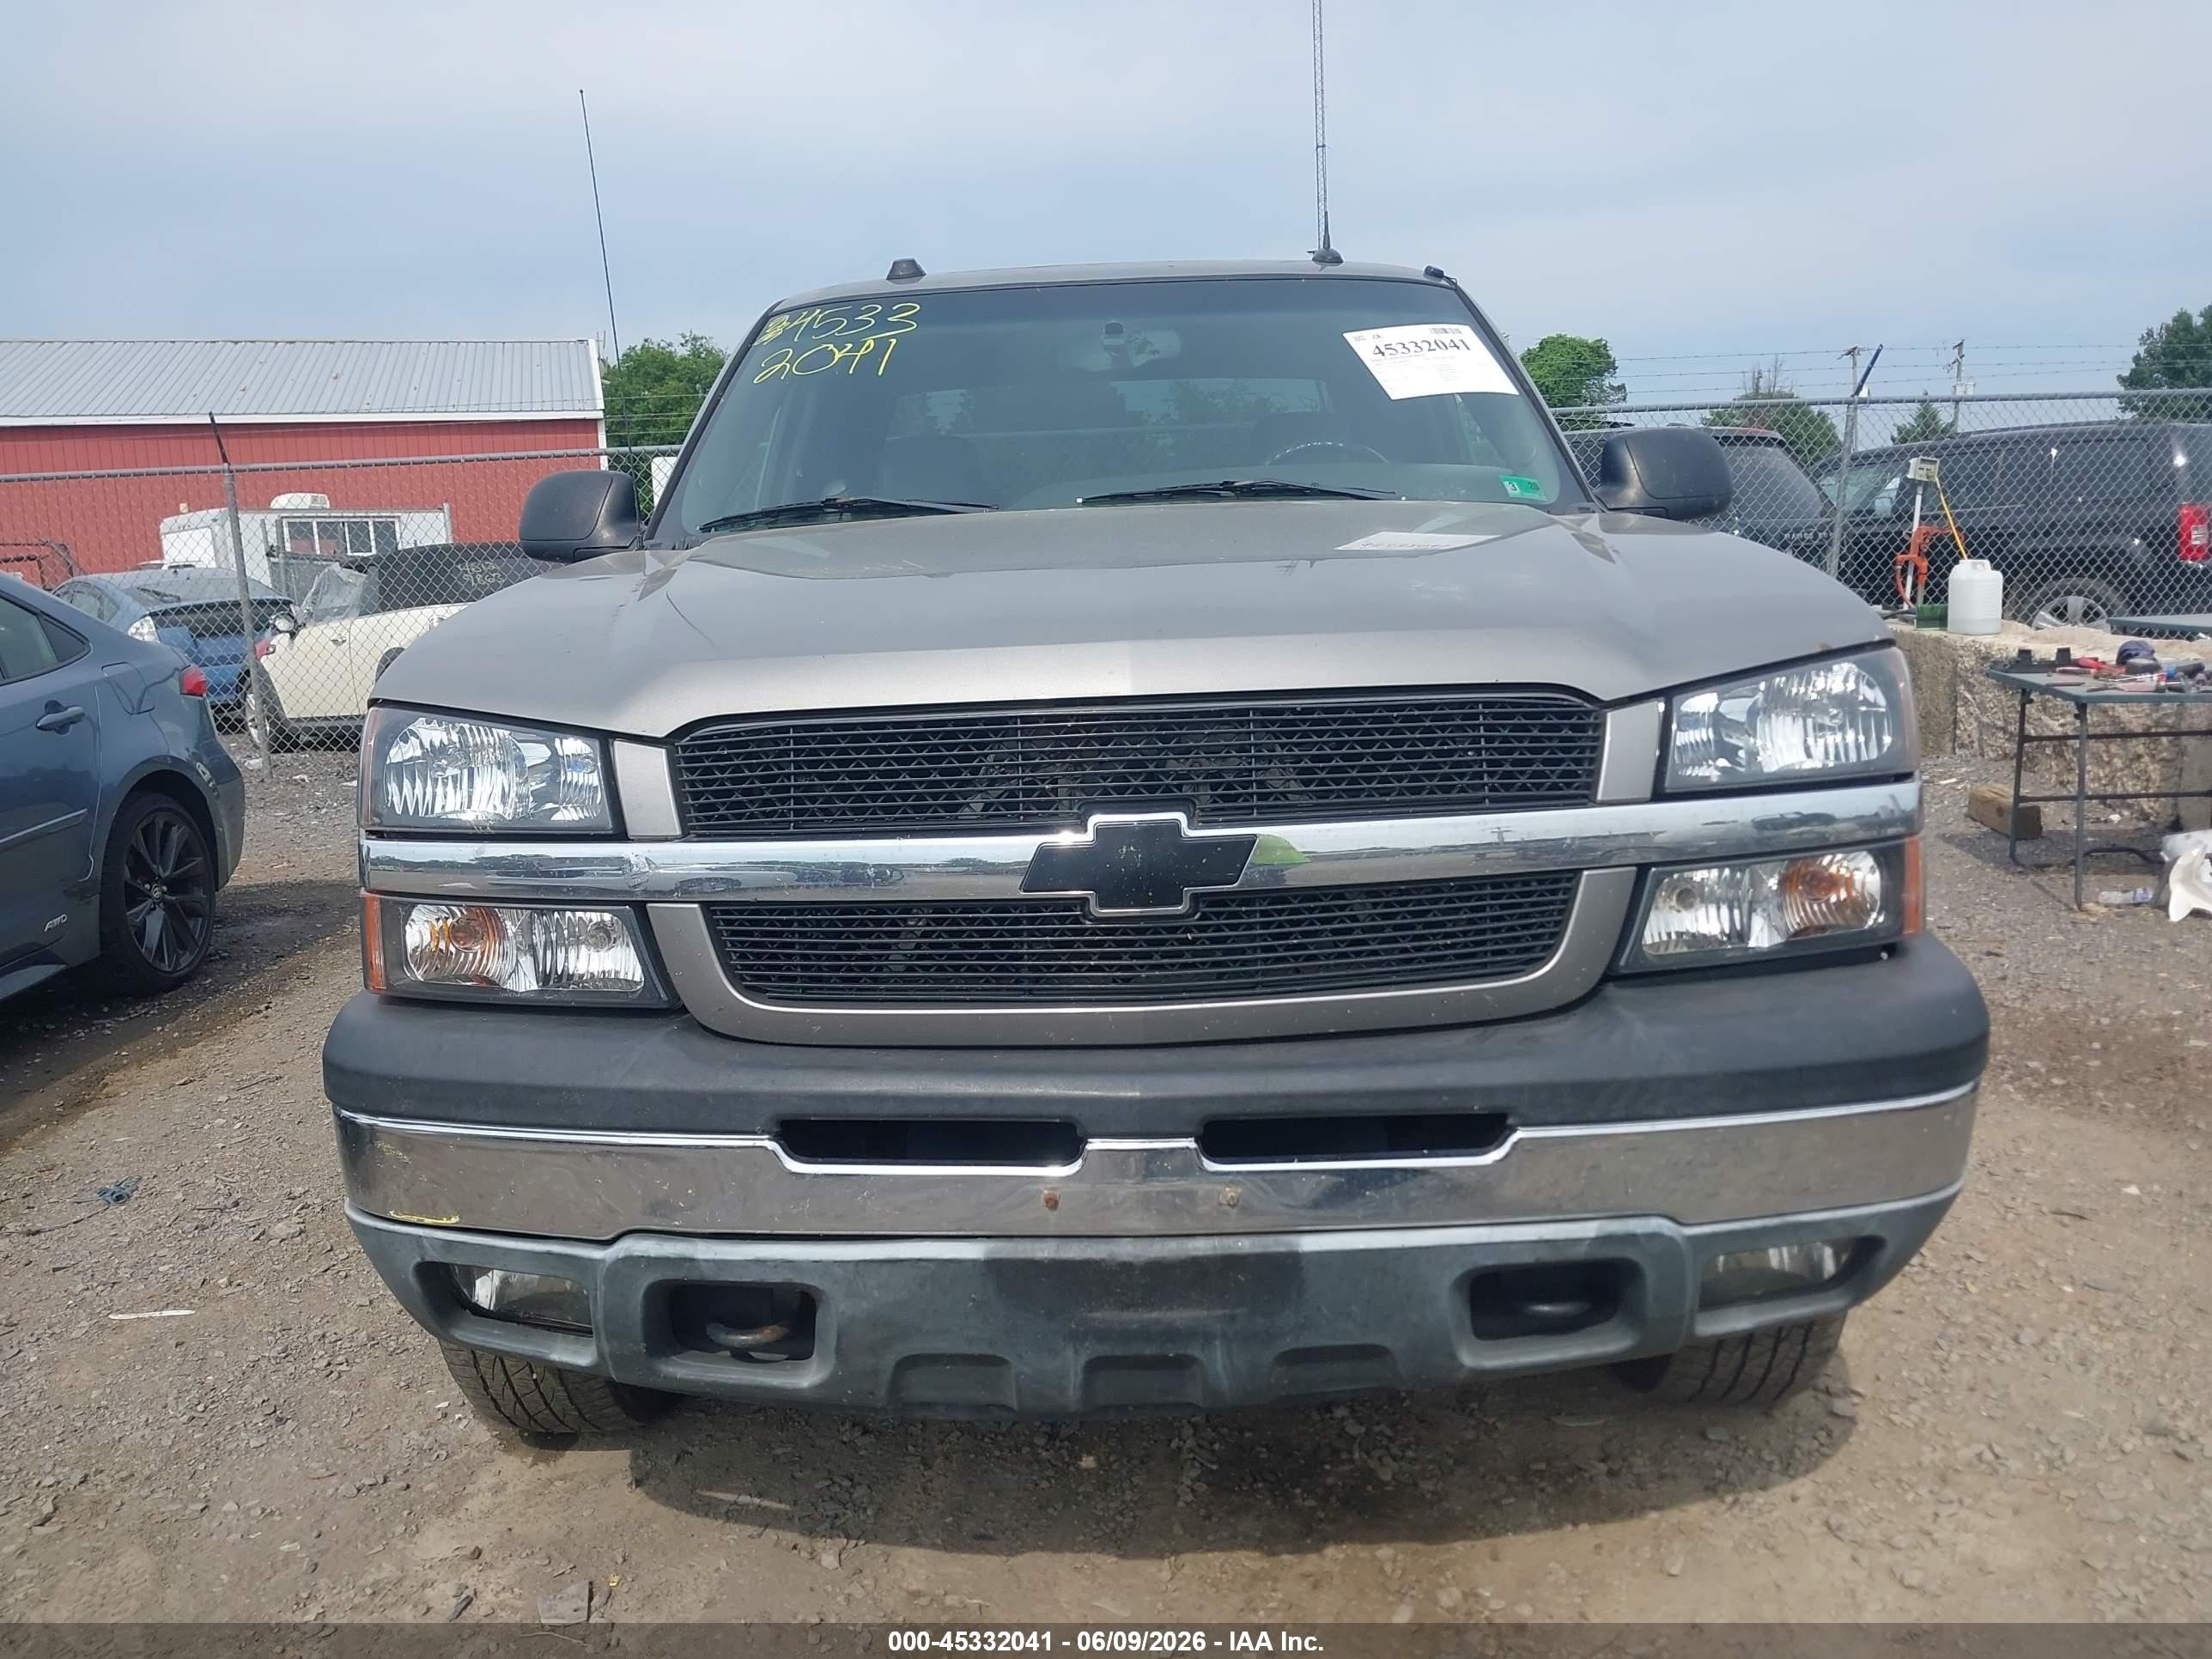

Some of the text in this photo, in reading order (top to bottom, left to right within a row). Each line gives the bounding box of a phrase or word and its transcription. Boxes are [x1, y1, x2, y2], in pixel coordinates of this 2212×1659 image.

[1372, 338, 1471, 357] 45332041
[753, 338, 896, 384] 2041
[1508, 481, 1517, 491] 3
